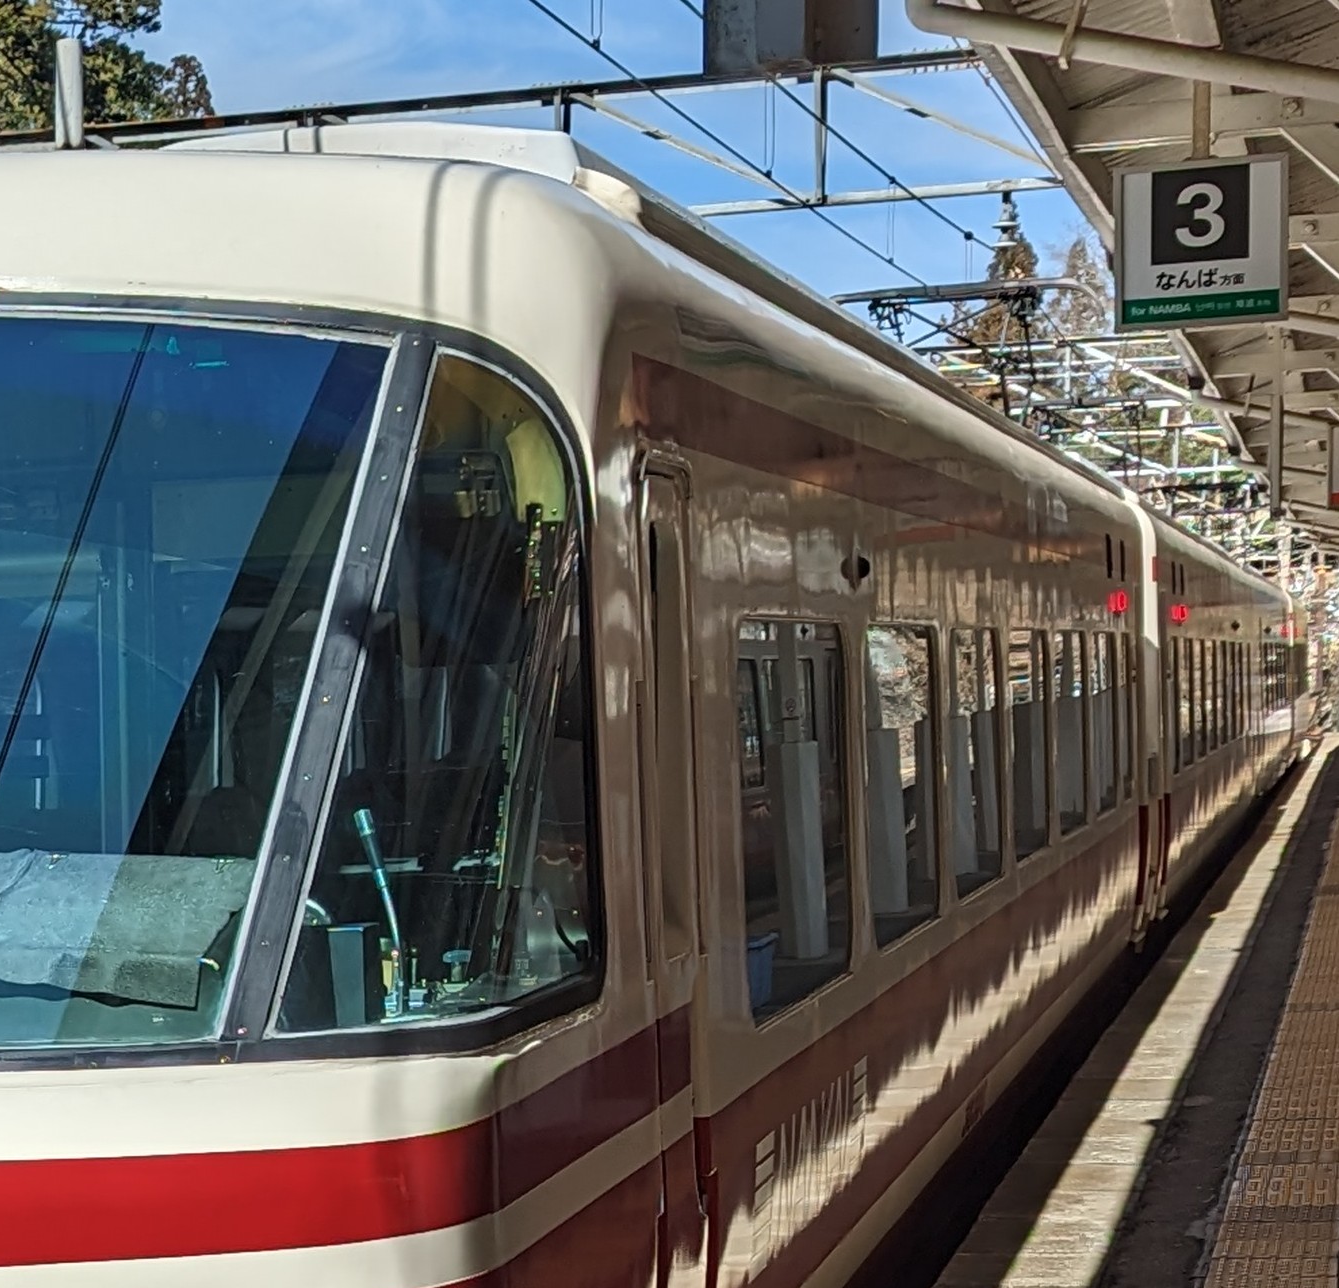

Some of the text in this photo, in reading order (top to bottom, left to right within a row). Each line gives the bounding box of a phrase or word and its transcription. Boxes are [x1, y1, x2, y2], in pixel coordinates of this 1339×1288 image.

[1175, 182, 1225, 247] 3
[1156, 268, 1246, 290] なんば方面
[1131, 305, 1146, 317] for
[1148, 303, 1192, 315] NAMBA
